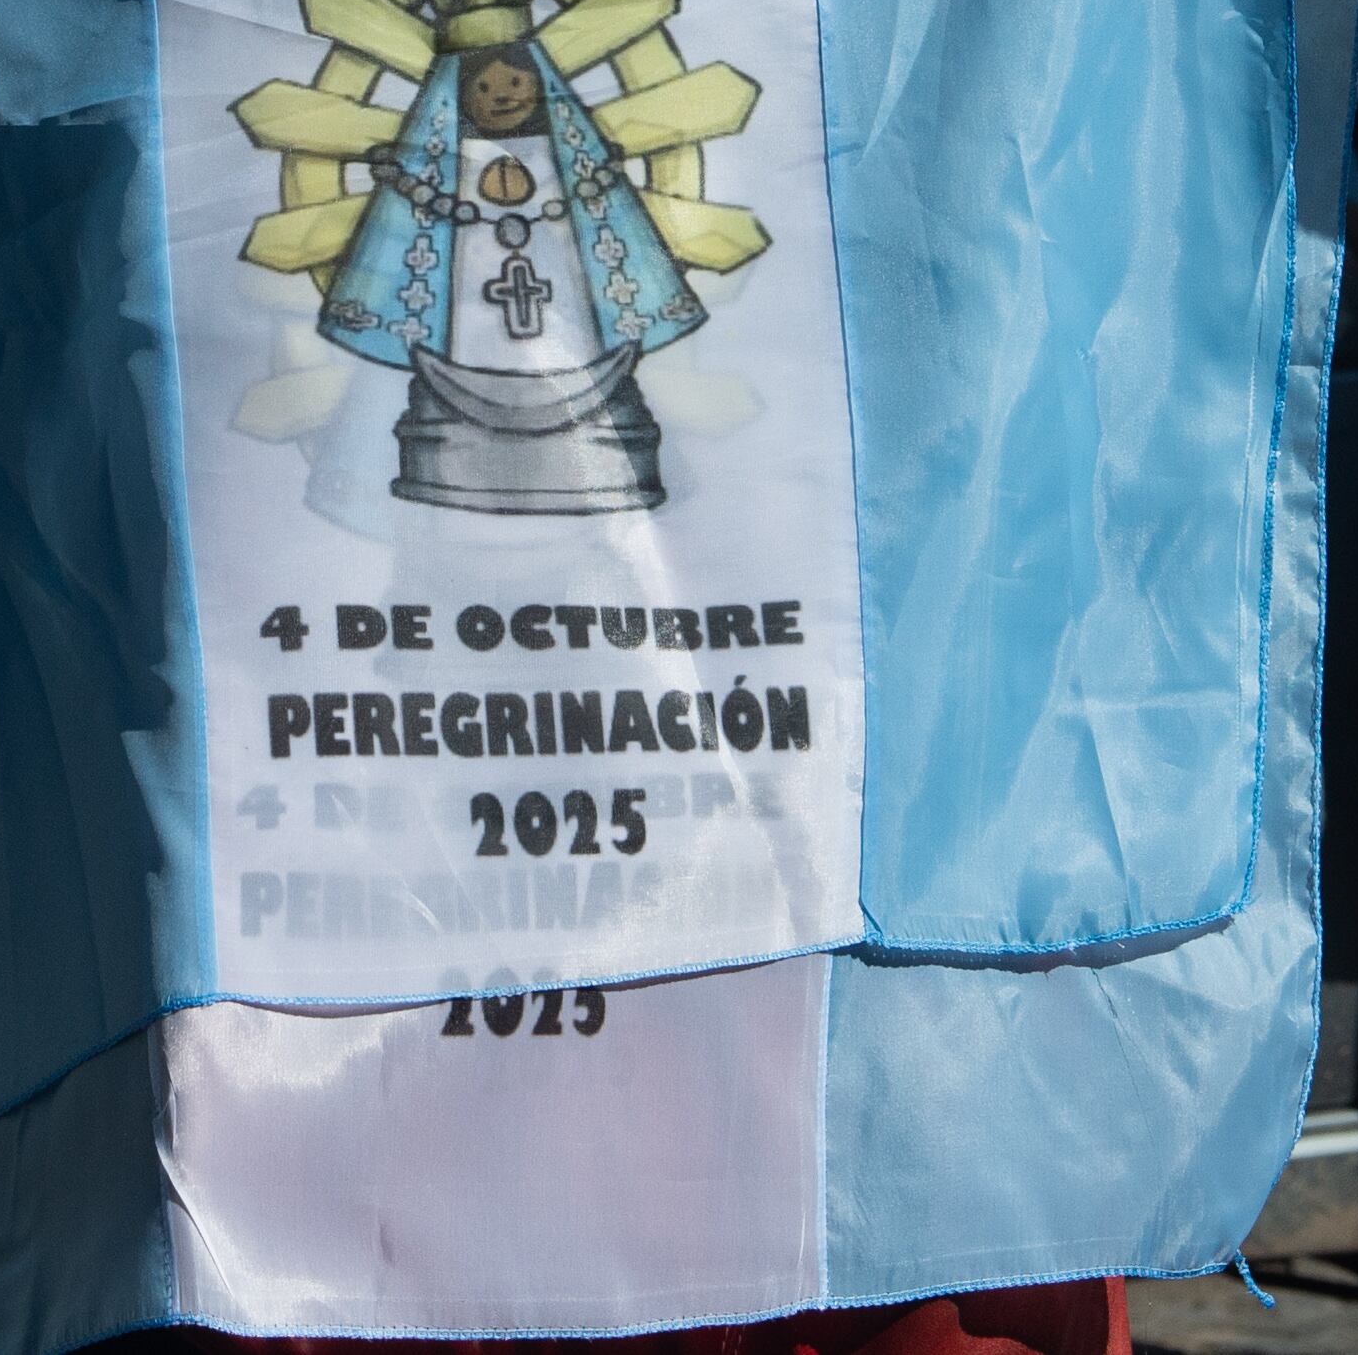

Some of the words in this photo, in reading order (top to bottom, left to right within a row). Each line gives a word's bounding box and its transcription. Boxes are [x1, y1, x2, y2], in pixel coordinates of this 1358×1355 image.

[260, 605, 309, 652] 4
[335, 604, 434, 650] DE
[455, 600, 804, 652] OCTUBRE
[267, 674, 811, 759] PEREGRINACIÓN
[470, 788, 646, 857] 2025
